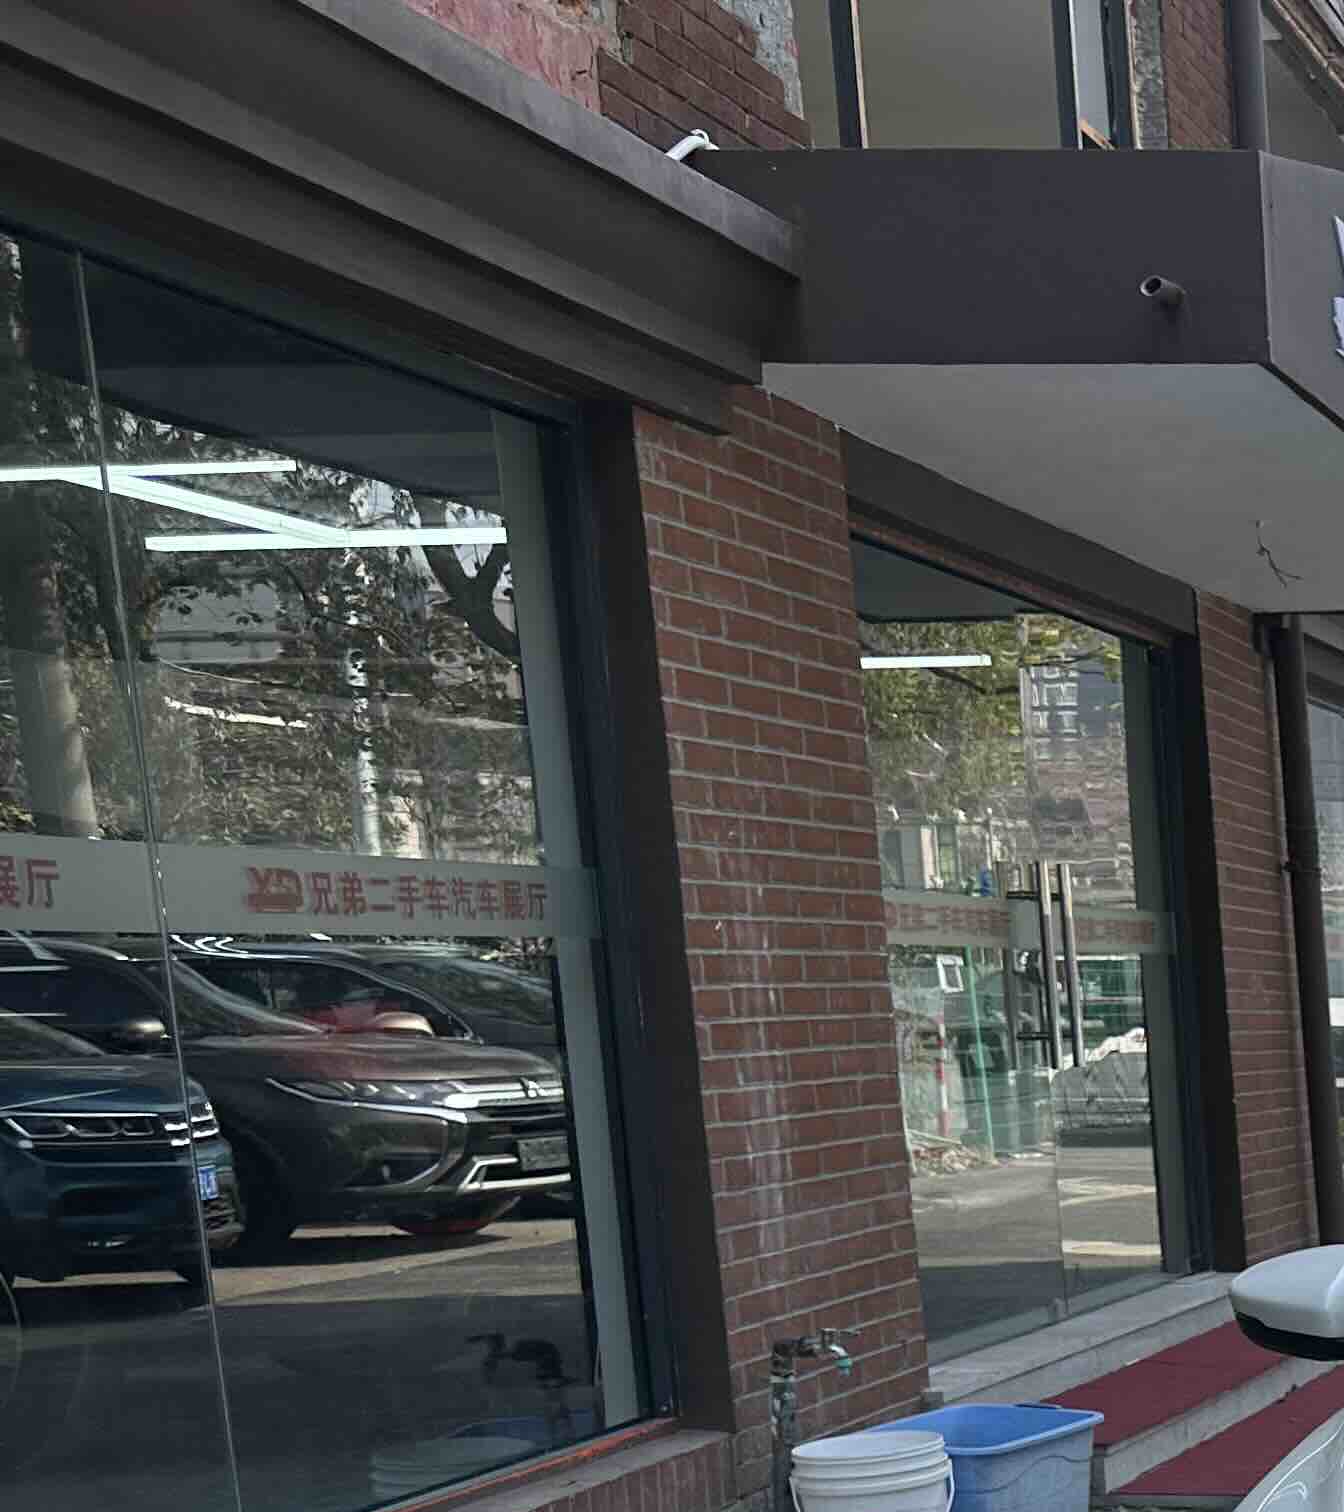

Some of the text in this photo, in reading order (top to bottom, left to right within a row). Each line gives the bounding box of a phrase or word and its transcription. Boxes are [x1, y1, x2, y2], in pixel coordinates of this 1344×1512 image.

[310, 861, 548, 920] 兄弟二手车汽车展厅
